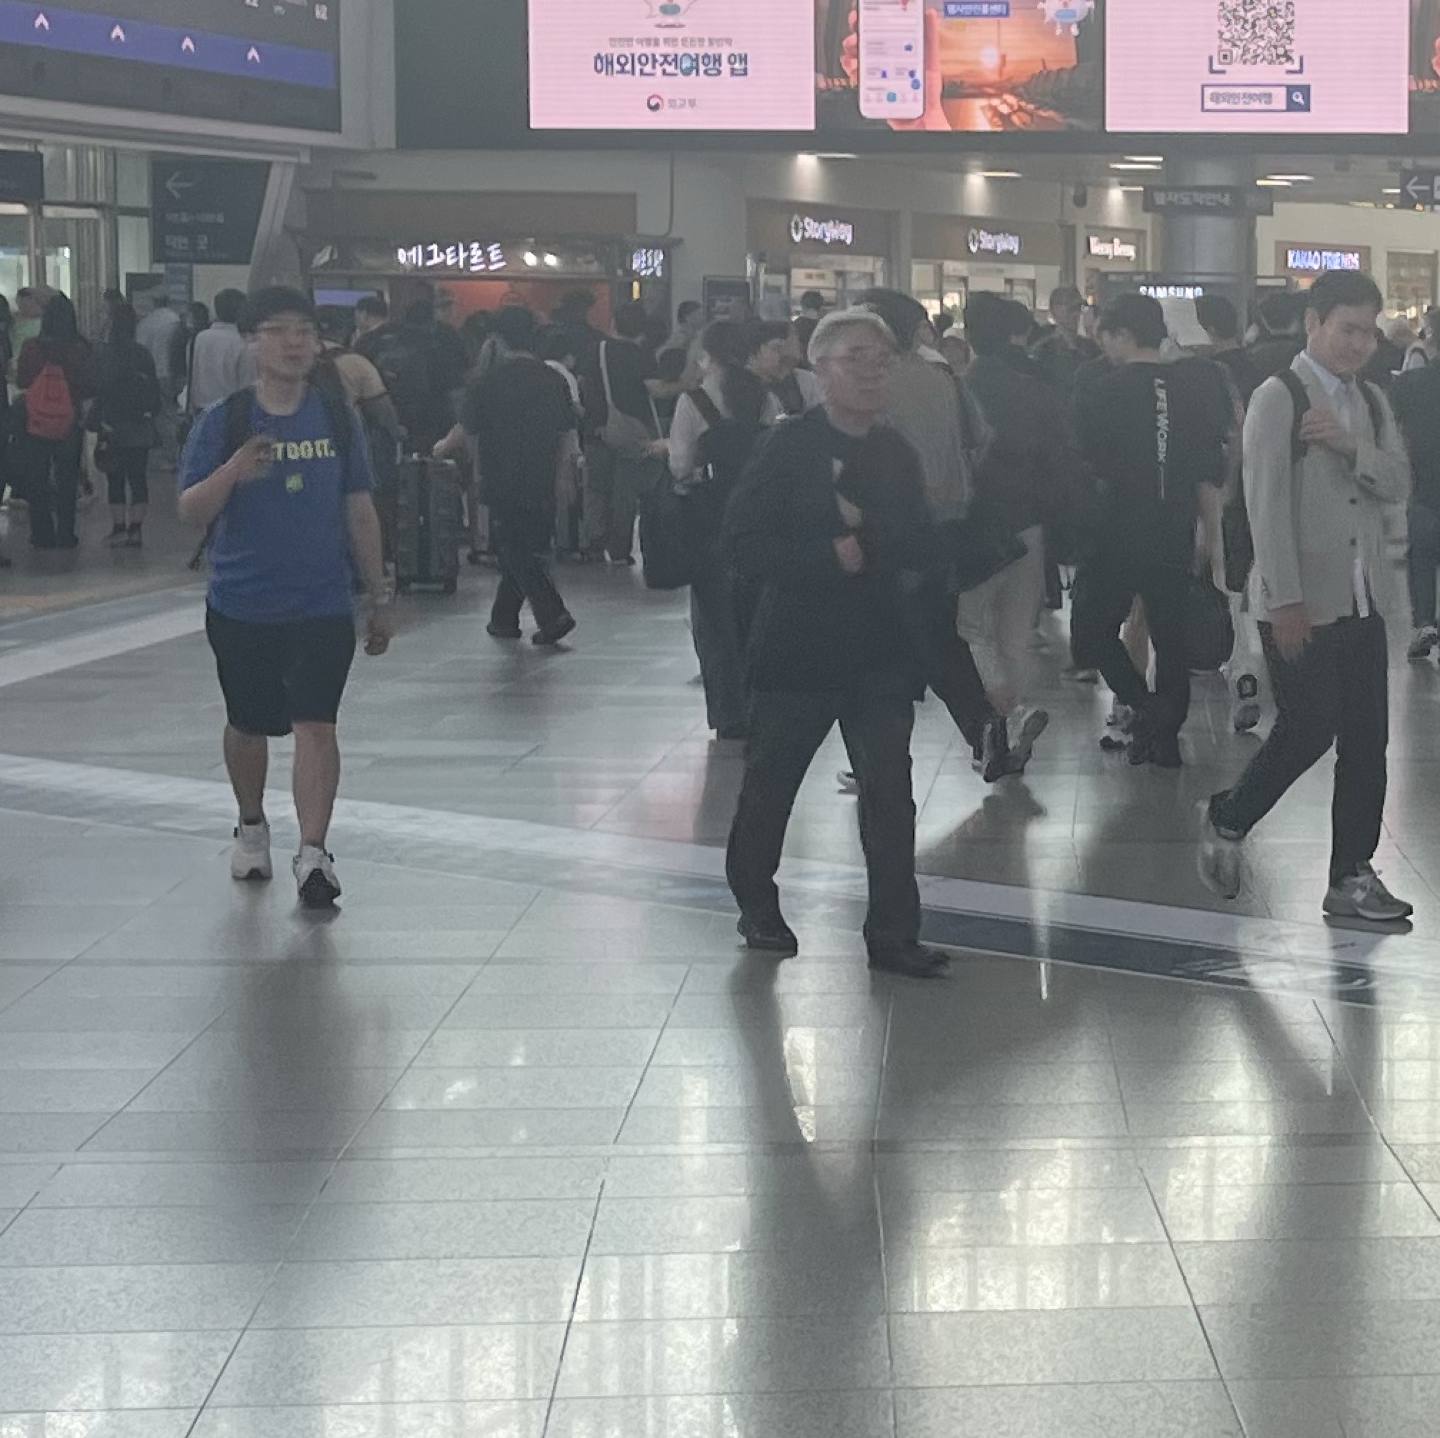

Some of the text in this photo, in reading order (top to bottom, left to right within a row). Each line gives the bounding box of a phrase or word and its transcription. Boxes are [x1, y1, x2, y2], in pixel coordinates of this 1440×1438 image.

[593, 52, 748, 77] 해외안전여행 앱
[668, 98, 697, 109] 외교부
[803, 216, 853, 245] Storyway
[397, 242, 507, 272] 에그타르트
[1288, 249, 1360, 270] KAKAO FRIENDS
